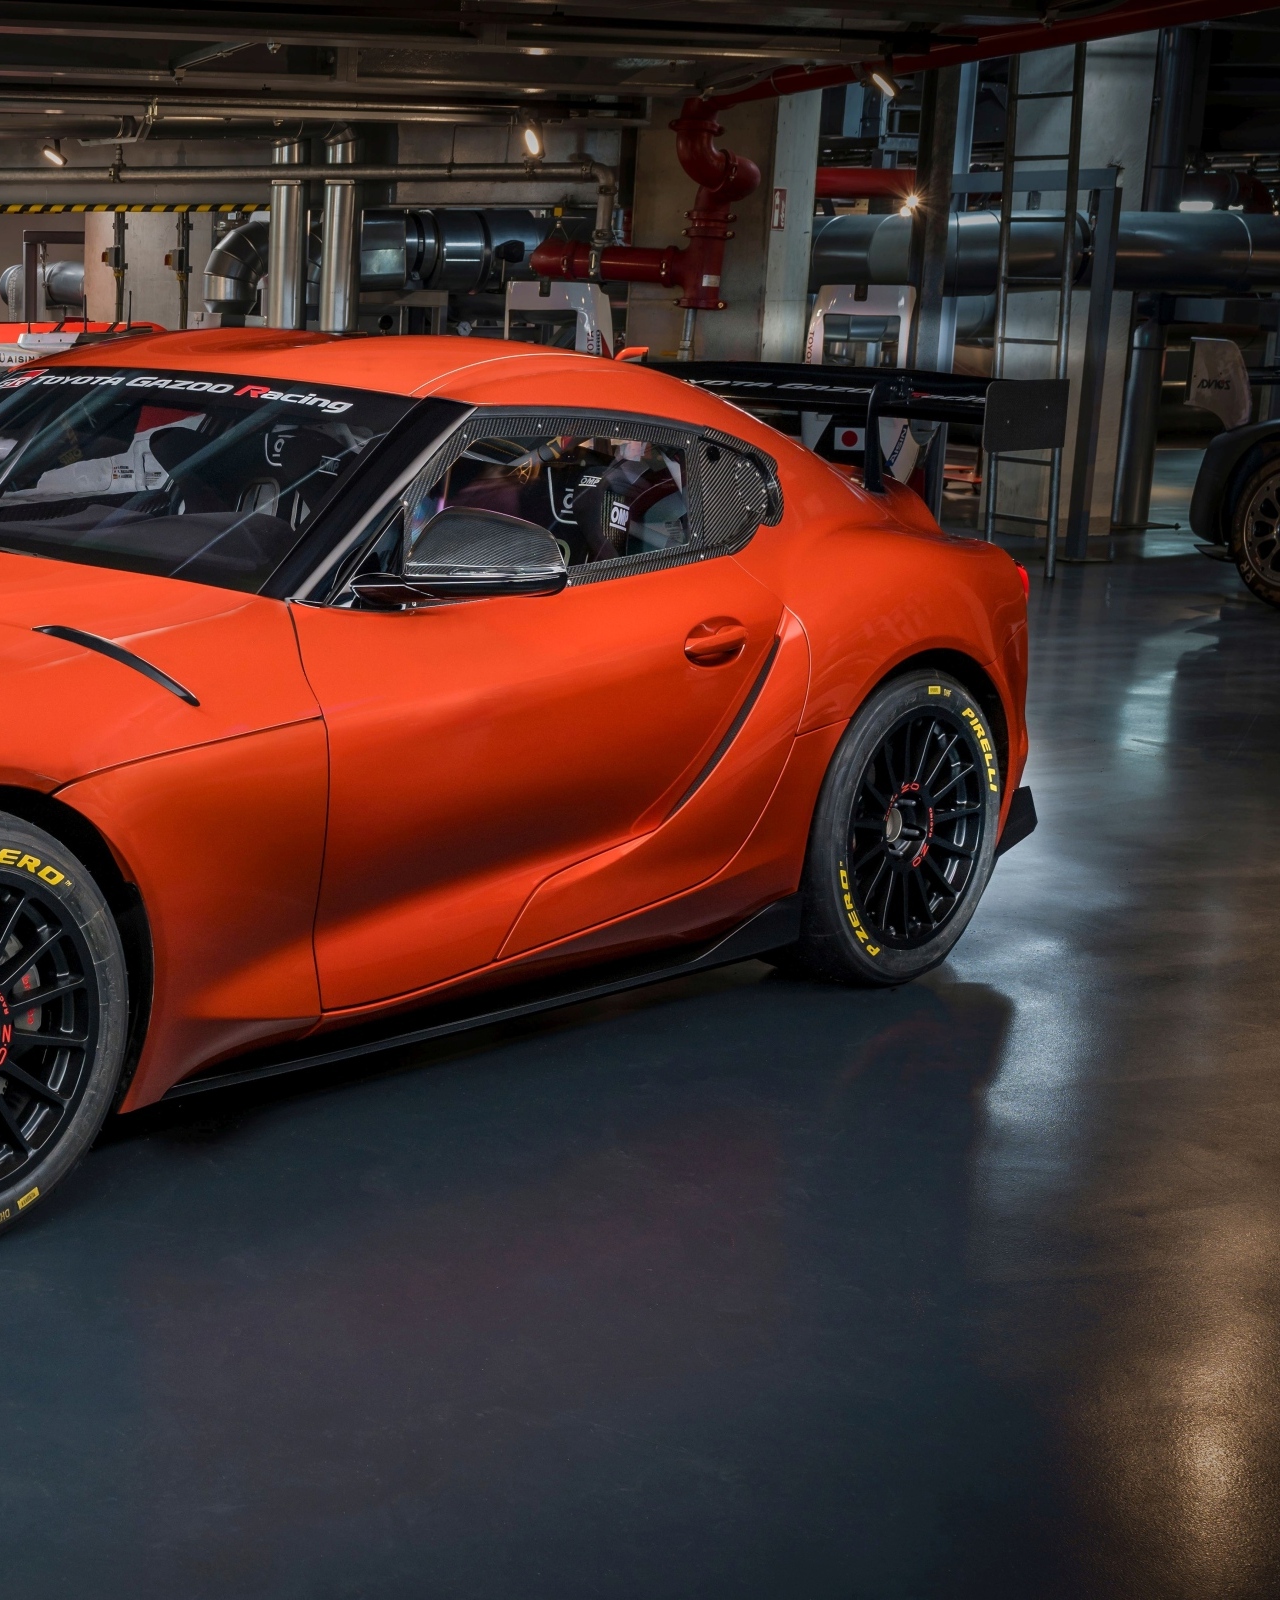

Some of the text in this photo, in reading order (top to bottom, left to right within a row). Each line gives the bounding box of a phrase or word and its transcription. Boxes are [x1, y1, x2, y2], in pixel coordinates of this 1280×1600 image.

[805, 331, 815, 364] TOYOT
[31, 375, 122, 386] TOYOTA
[125, 376, 235, 394] GAZOO
[233, 385, 354, 414] Racing
[685, 379, 773, 388] YOTA
[579, 477, 600, 485] OMP
[610, 505, 629, 527] OMP
[961, 707, 998, 792] PIRELLI
[839, 869, 869, 944] ZERO
[866, 944, 880, 957] P
